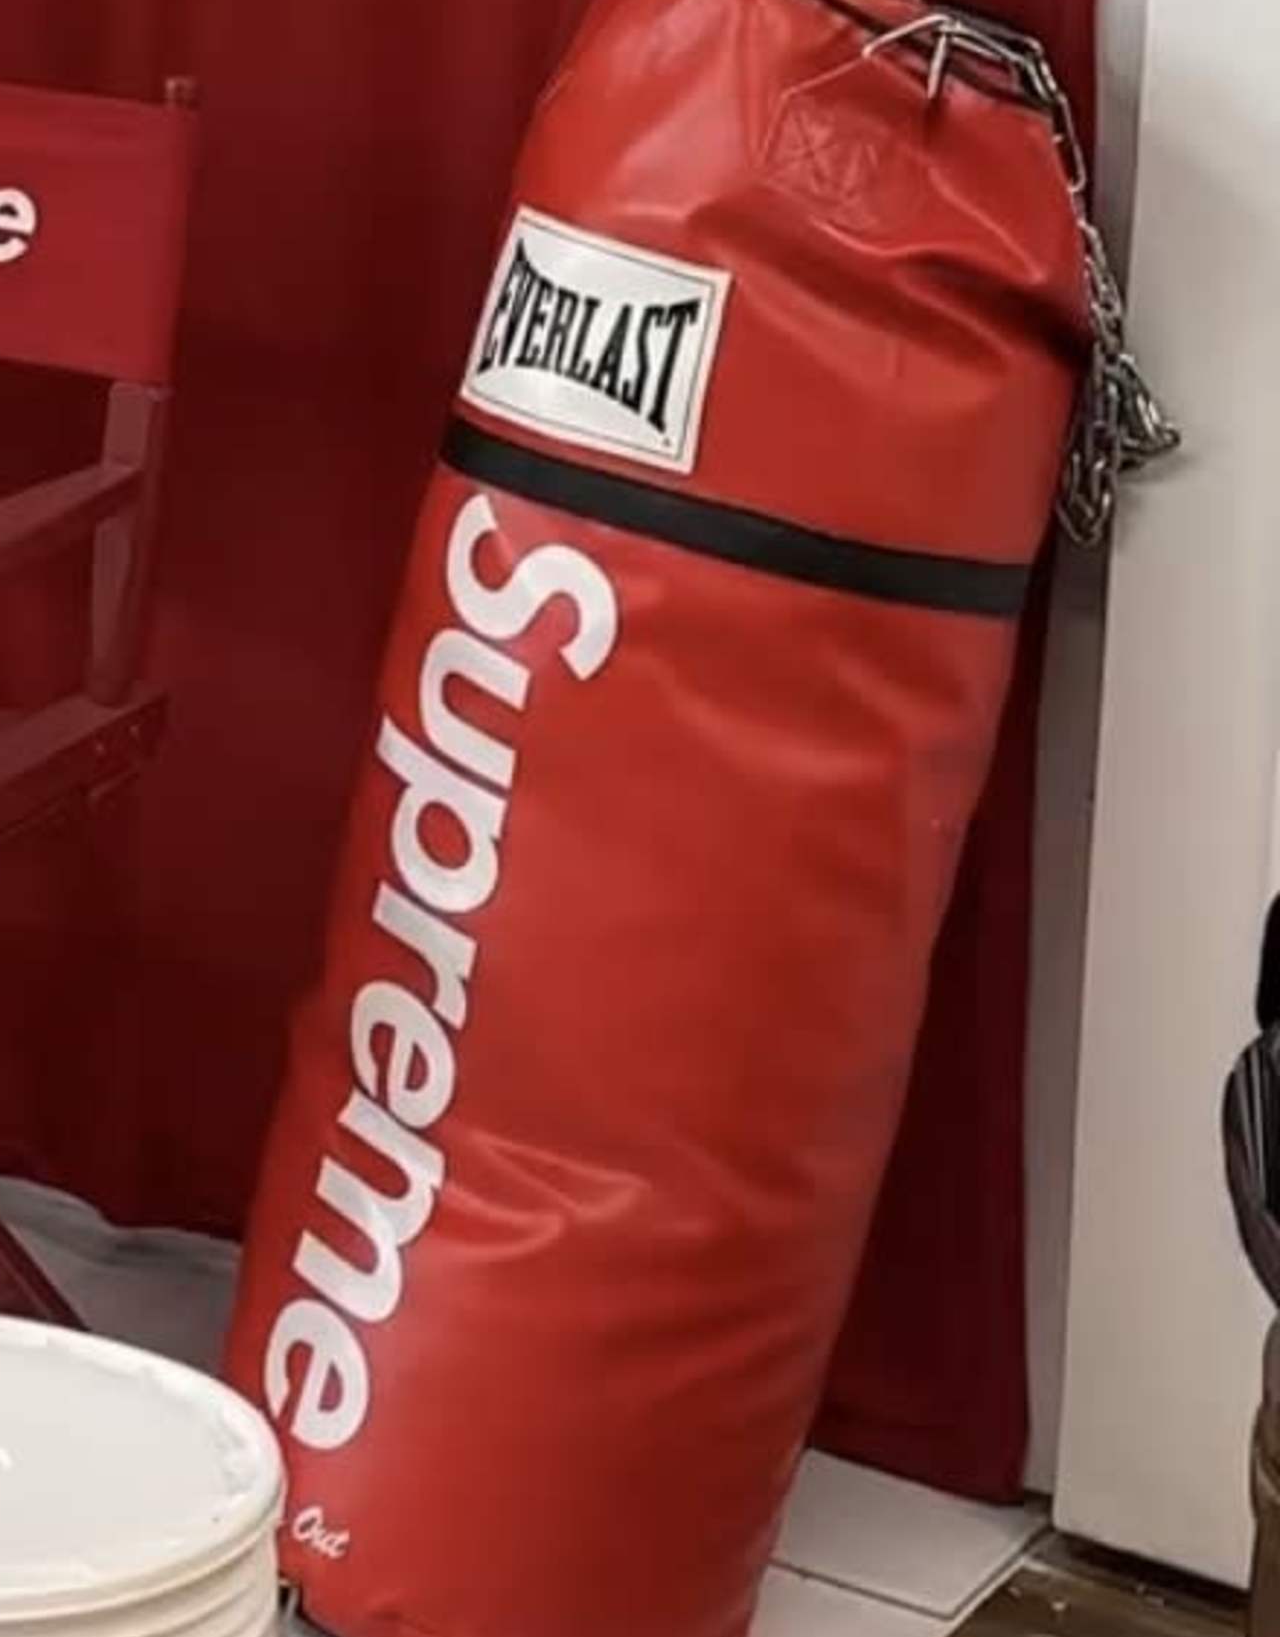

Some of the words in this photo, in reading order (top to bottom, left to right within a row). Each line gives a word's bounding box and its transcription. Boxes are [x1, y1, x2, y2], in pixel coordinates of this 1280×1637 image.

[476, 237, 702, 433] EVERLAST
[264, 492, 618, 1450] Supreme
[293, 1505, 350, 1559] Out
